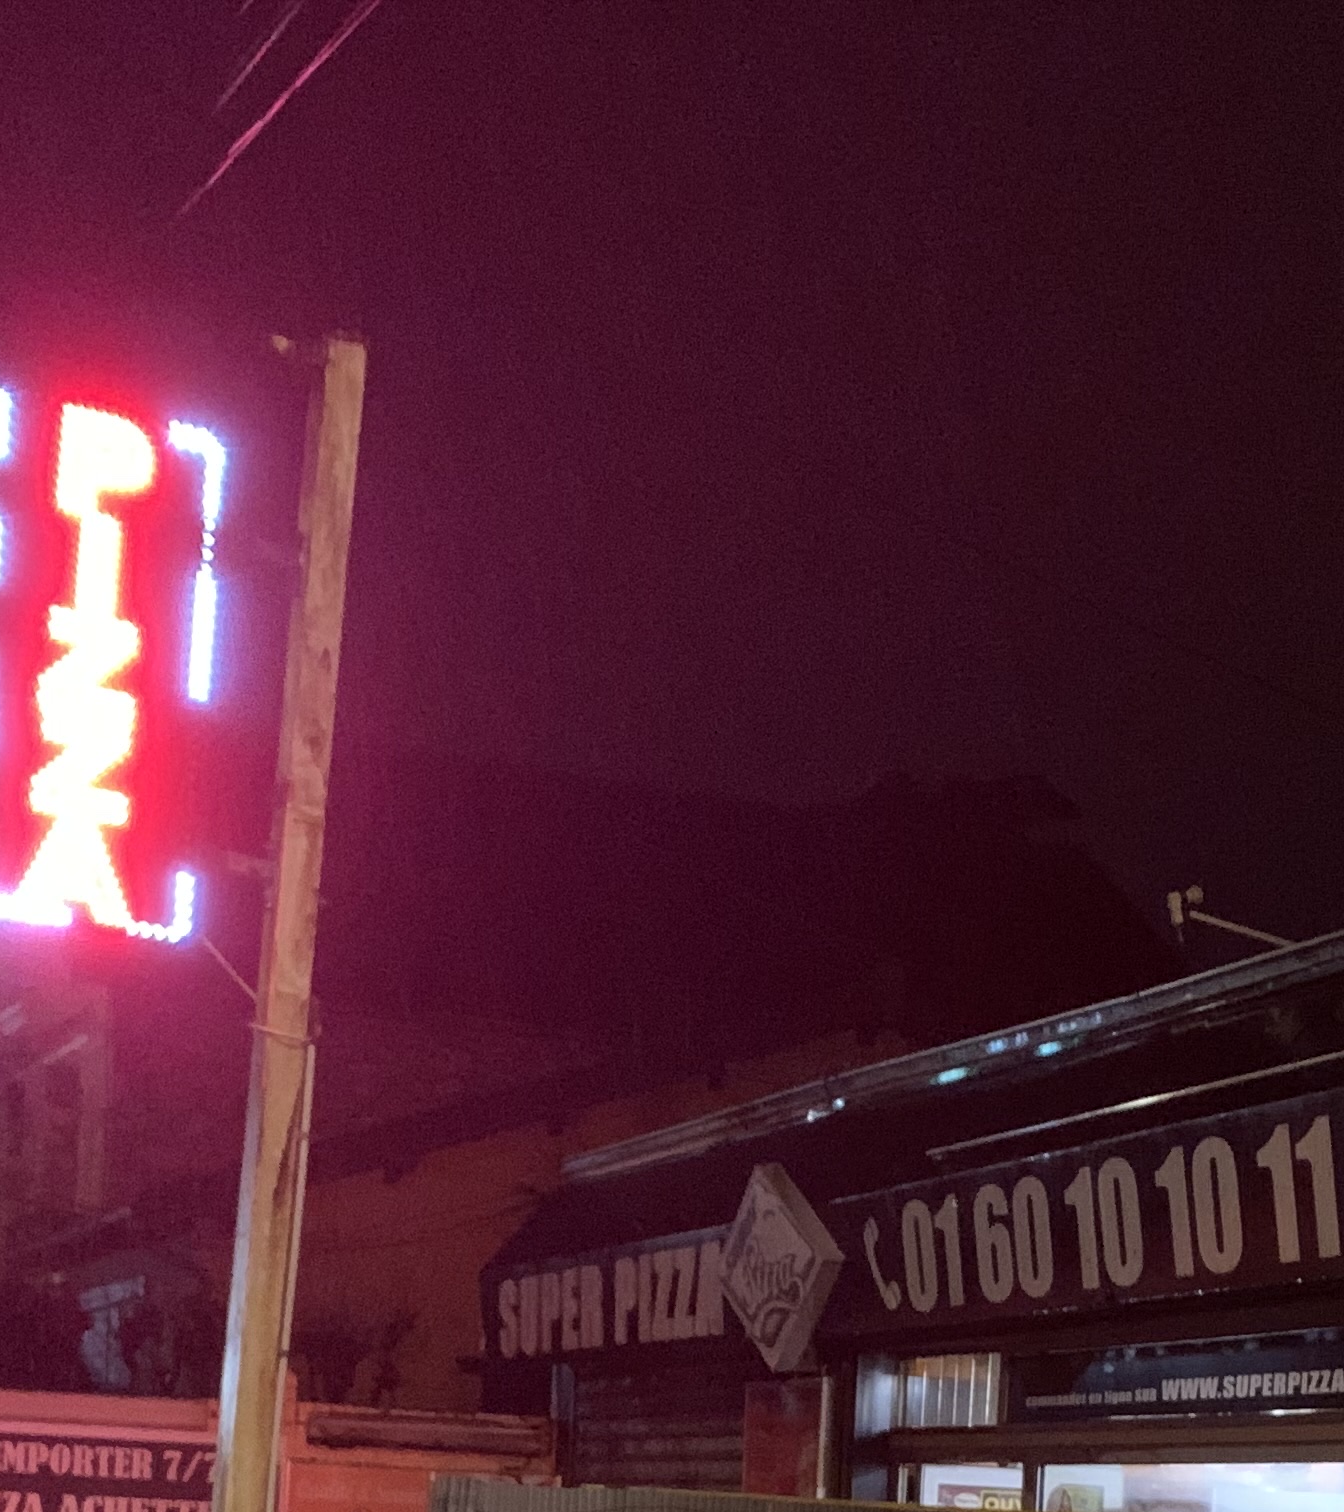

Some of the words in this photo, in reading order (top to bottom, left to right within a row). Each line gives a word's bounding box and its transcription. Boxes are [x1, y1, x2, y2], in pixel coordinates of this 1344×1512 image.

[14, 402, 156, 926] PIZZA
[498, 1265, 604, 1359] SUPER
[614, 1239, 725, 1346] PIZZA
[901, 1193, 964, 1312] 01
[973, 1175, 1054, 1304] 60
[1064, 1157, 1145, 1291] 10
[1155, 1136, 1244, 1278] 10
[1256, 1114, 1341, 1264] 11
